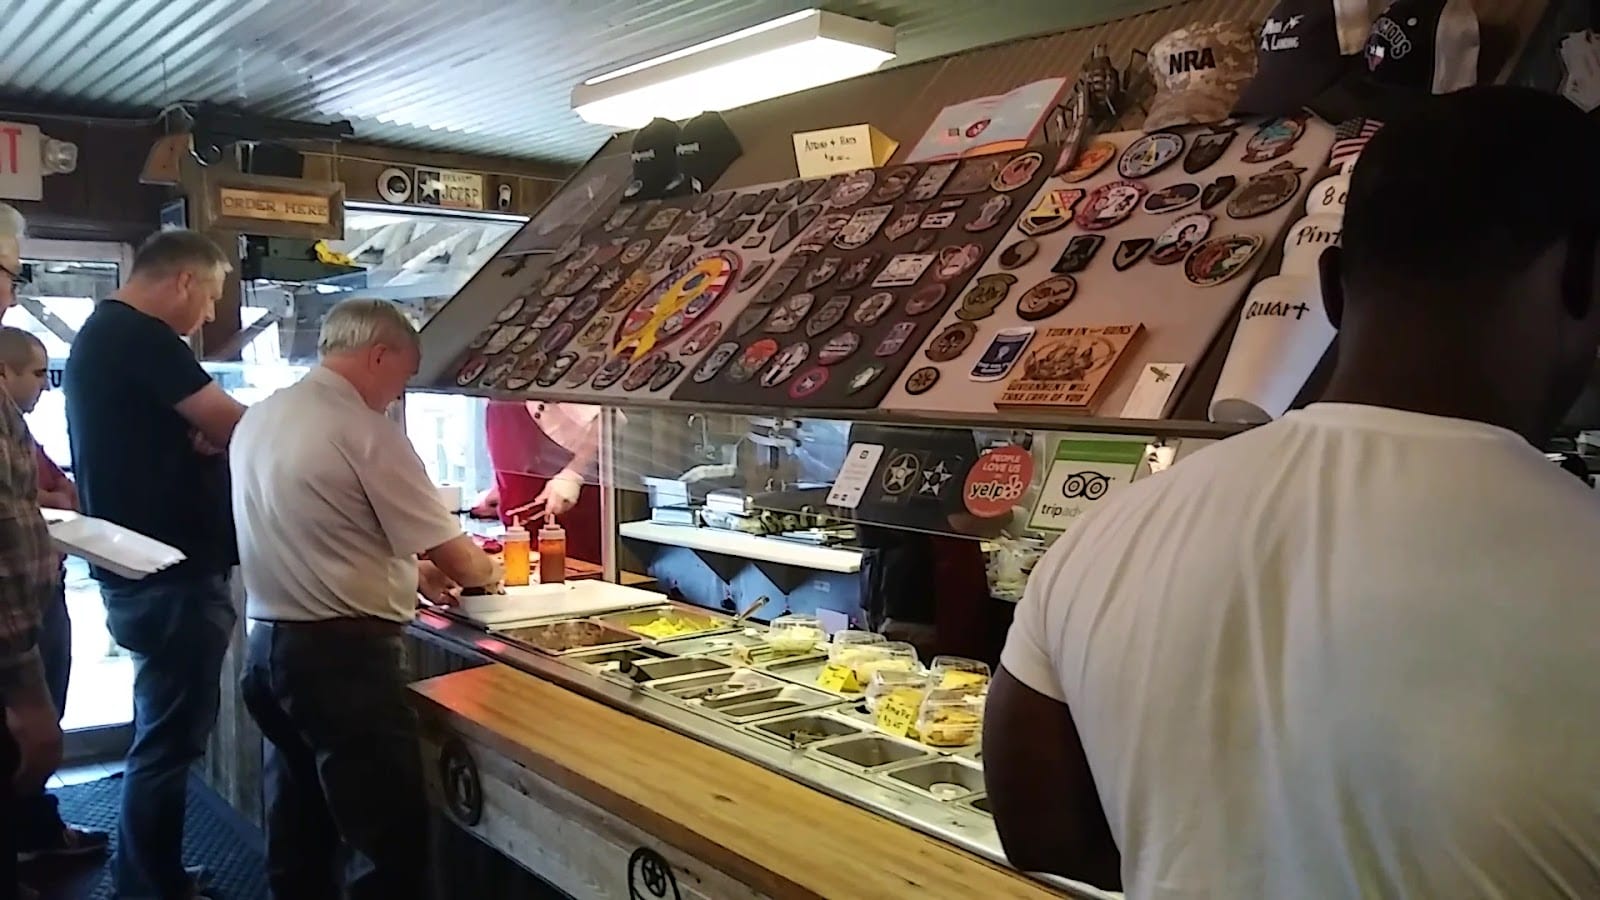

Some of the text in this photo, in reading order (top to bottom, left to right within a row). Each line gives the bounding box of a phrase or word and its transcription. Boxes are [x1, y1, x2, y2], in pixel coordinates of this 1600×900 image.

[1169, 47, 1216, 75] NRA
[0, 127, 22, 173] T
[223, 196, 328, 216] ORDER HERE
[1245, 301, 1310, 320] Quart
[1046, 328, 1074, 337] TURN
[1074, 328, 1088, 337] IN
[1007, 383, 1091, 392] GOVERNMENT WILL
[1001, 393, 1085, 402] TAKE CARE OF YOU
[990, 454, 1021, 463] PEOPLE
[982, 463, 1021, 473] LOVE US
[969, 480, 1004, 502] yelp
